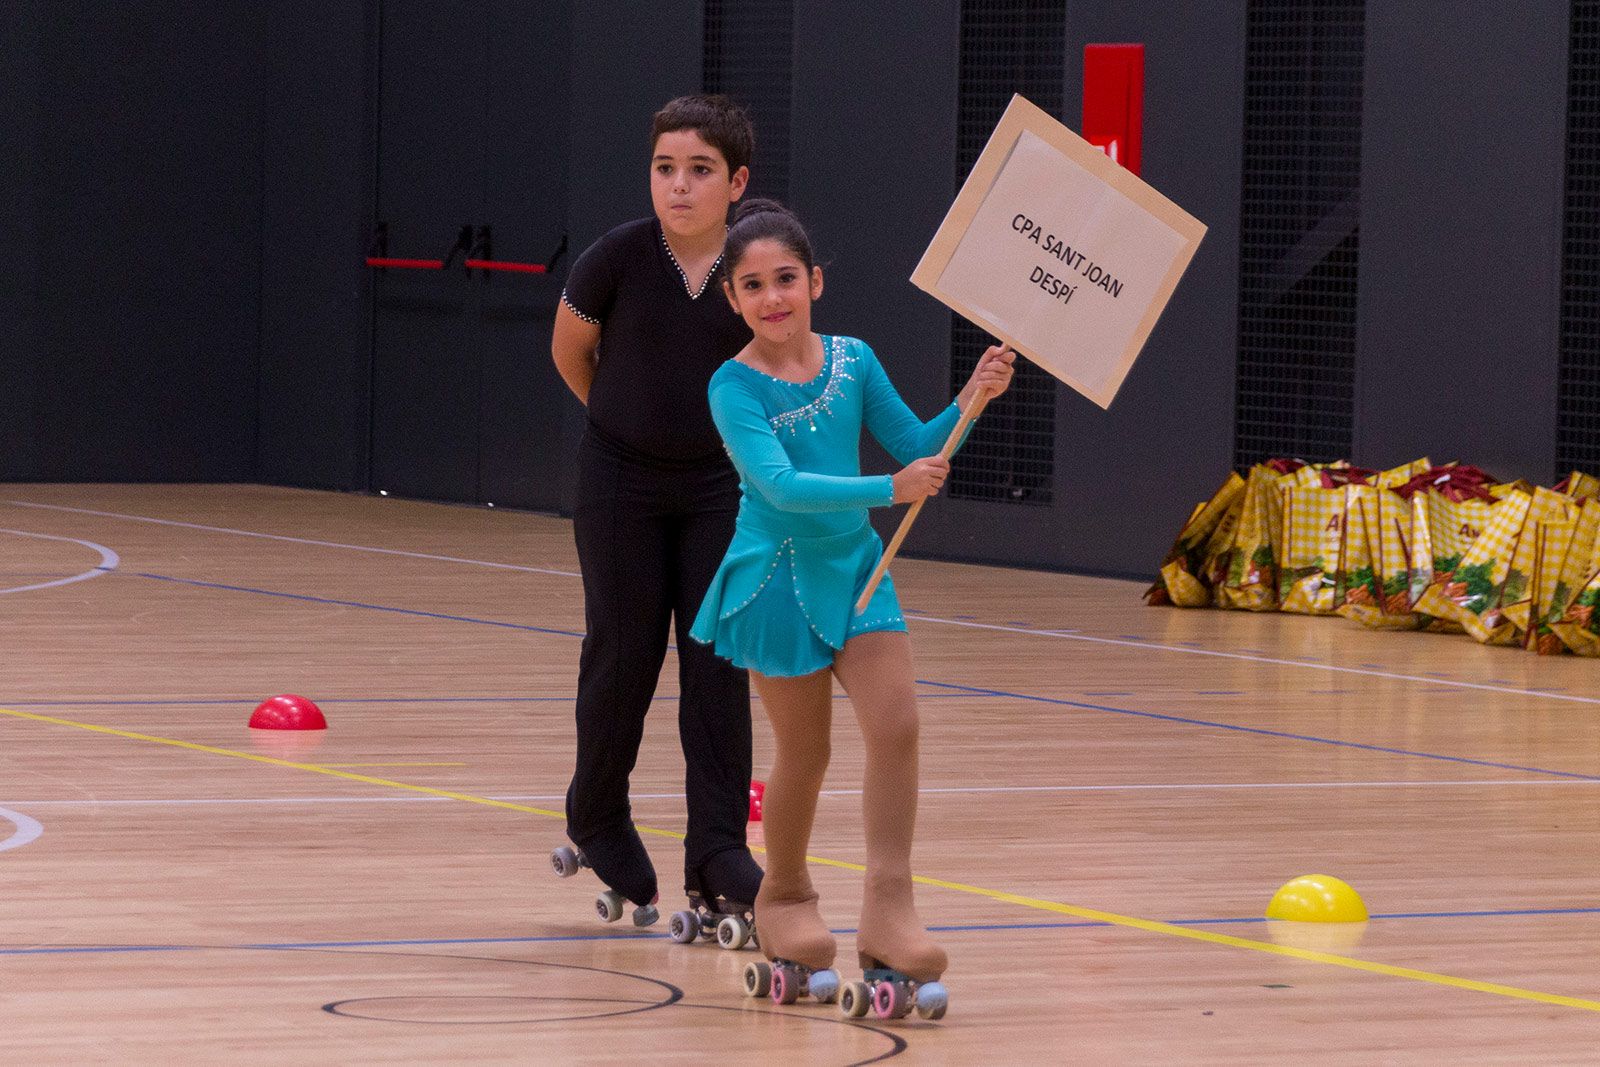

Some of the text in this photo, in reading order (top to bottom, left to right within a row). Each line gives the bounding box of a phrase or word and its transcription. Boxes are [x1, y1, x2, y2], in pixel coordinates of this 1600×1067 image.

[1012, 214, 1124, 298] CPA SANT JOAN
[1029, 266, 1078, 305] DESPÍ
